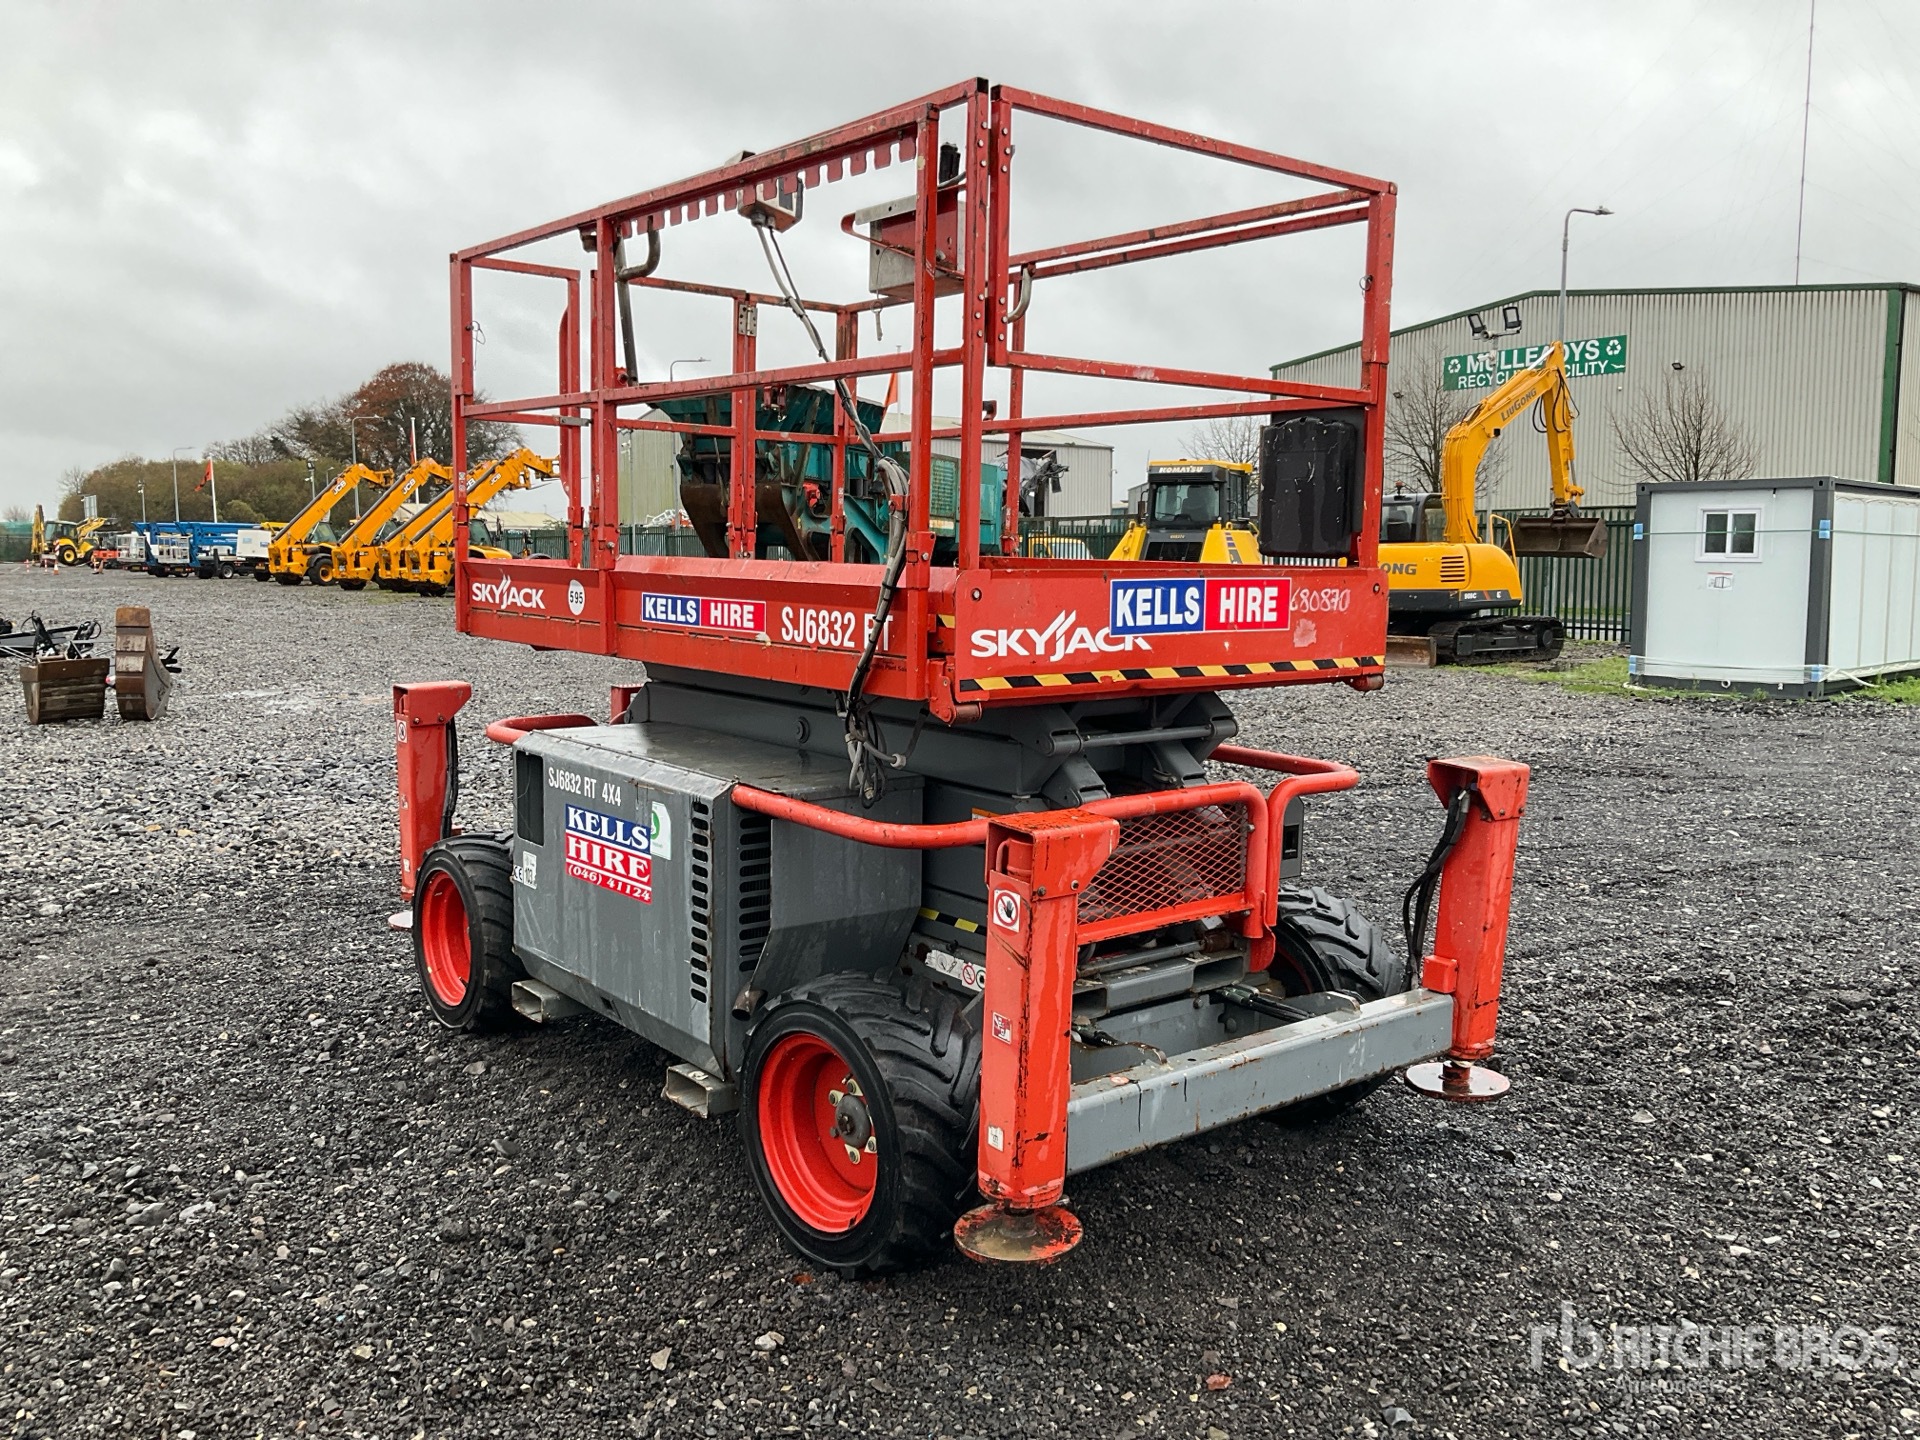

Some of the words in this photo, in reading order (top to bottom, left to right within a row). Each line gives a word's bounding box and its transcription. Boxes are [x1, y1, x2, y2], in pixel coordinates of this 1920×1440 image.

[1466, 339, 1600, 374] MULLEYS
[1564, 360, 1609, 378] CILITY
[490, 473, 502, 485] JCB
[1158, 465, 1204, 473] KOMATSU
[333, 480, 347, 495] JCB
[403, 478, 416, 494] JCB
[472, 574, 546, 609] SKYJACK
[569, 590, 584, 605] 595
[1116, 586, 1200, 627] KELLS
[1219, 587, 1278, 623] HIRE
[1290, 587, 1351, 613] 680870
[645, 597, 697, 623] KELLS
[709, 602, 754, 629] HIRE
[781, 606, 856, 648] SJ6832
[548, 766, 581, 795] SJ6832
[584, 776, 597, 799] RT
[602, 782, 621, 807] 4X4
[567, 806, 649, 850] KELLS
[567, 835, 650, 883] HIRE
[568, 864, 603, 885] (046)
[607, 877, 651, 901] 41124
